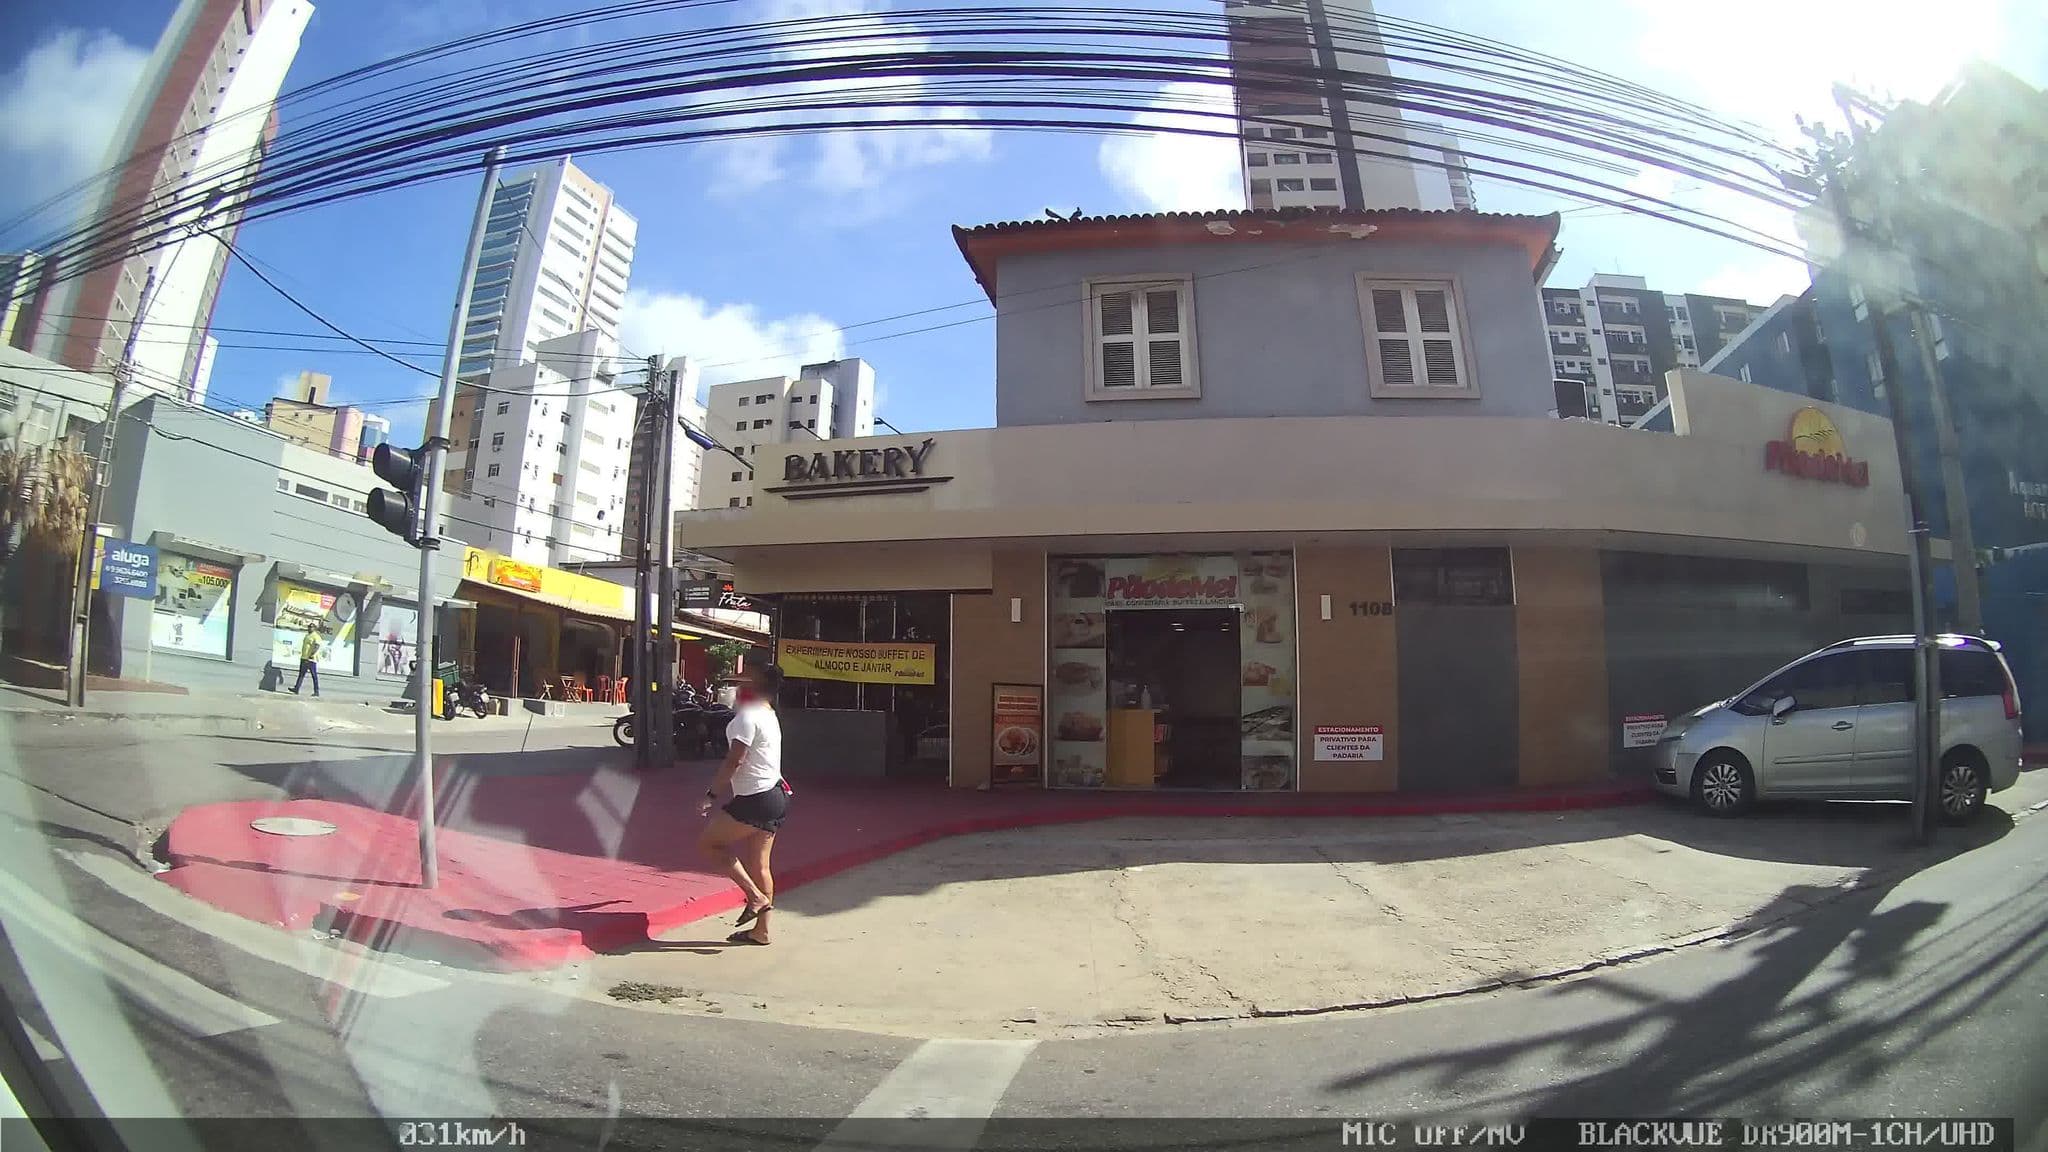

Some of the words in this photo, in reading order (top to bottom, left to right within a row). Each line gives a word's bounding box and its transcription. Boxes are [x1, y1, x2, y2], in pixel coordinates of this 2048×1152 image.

[783, 438, 933, 480] BAKERY
[2023, 502, 2048, 519] HOT
[112, 549, 149, 567] aluga
[1349, 601, 1392, 616] 1108
[845, 648, 876, 659] NOSSO
[912, 650, 925, 660] DE
[853, 661, 859, 671] E
[861, 662, 891, 673] JANTAR
